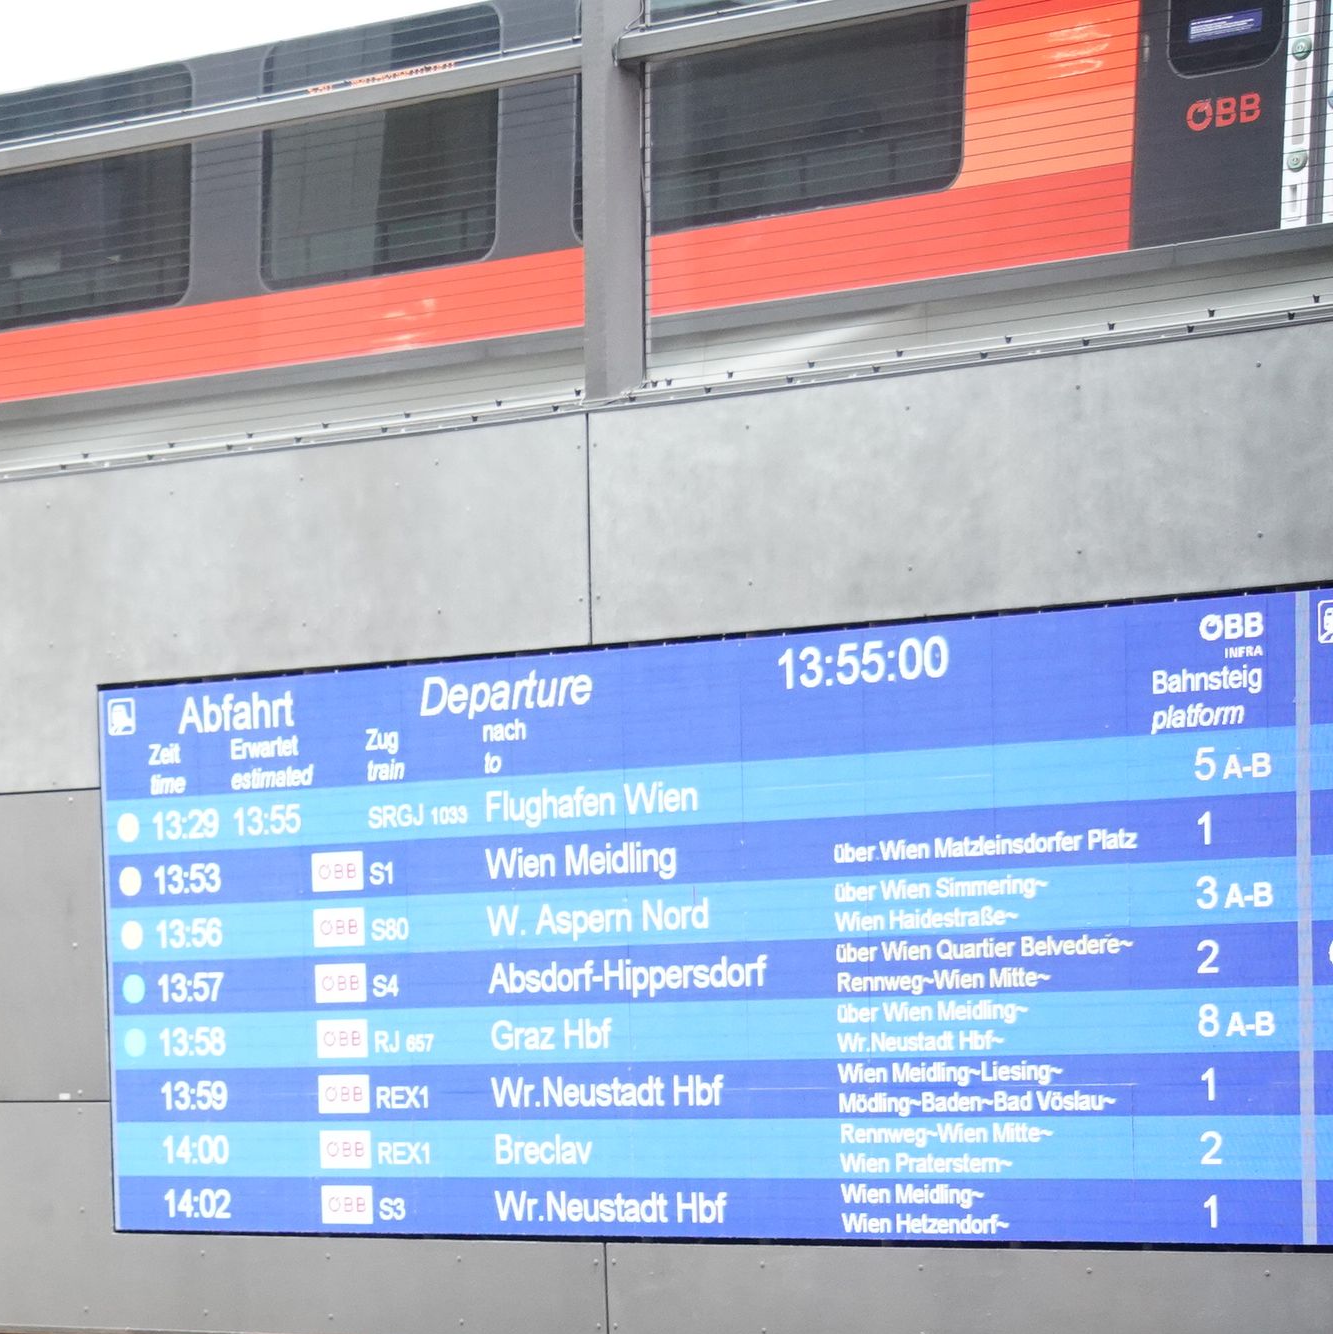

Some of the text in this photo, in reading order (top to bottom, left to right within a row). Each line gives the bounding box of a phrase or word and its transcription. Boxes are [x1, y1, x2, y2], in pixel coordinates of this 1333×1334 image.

[1186, 92, 1261, 131] ÖBB
[1199, 612, 1263, 641] ÖBB
[1225, 645, 1263, 658] INFRA
[179, 636, 948, 734] Abfahrt Departure 13:55:00
[149, 664, 1262, 765] Zeit Erwartet Zug nach Bahnsteig
[151, 703, 1244, 795] time estimated train to platform
[1195, 747, 1271, 781] 5 A-B
[153, 808, 219, 840] 13:29
[234, 804, 301, 836] 13:55
[431, 806, 468, 824] 1033
[486, 786, 615, 828] Flughafen
[624, 781, 698, 814] Wien
[1198, 811, 1211, 844] 1
[834, 829, 1137, 863] über Wien Matzleinsdorfer Platz
[155, 863, 221, 894] 13:53
[370, 862, 393, 885] S1
[485, 848, 555, 879] Wien
[565, 842, 676, 879] Meidling
[835, 882, 876, 902] über
[880, 880, 931, 900] Wien
[1196, 876, 1273, 909] 3 A-B
[156, 917, 222, 948] 13:56
[372, 918, 409, 941] S80
[487, 905, 525, 936] W.
[536, 904, 632, 941] Aspern
[642, 897, 709, 931] Nord
[835, 911, 885, 932] Wien
[836, 943, 877, 963] über
[881, 941, 932, 961] Wien
[937, 938, 1016, 960] Quartier
[1197, 940, 1219, 973] 2
[158, 972, 224, 1002] 13:57
[373, 975, 399, 997] S4
[489, 955, 767, 998] Absdorf-Hippersdorf
[837, 1003, 879, 1023] über
[883, 1002, 933, 1022] Wien
[1198, 1004, 1275, 1037] 8 A-B
[160, 1026, 226, 1056] 13:58
[375, 1031, 400, 1053] RJ
[406, 1034, 434, 1052] 657
[491, 1020, 555, 1050] Graz
[564, 1018, 612, 1049] Hbf
[837, 1031, 954, 1052] Wr.Neustadt
[838, 1063, 888, 1083] Wien
[1201, 1068, 1215, 1100] 1
[161, 1081, 228, 1110] 13:59
[376, 1086, 428, 1108] REX1
[491, 1076, 664, 1107] Wr.Neustadt
[674, 1074, 723, 1106] Hbf
[163, 1135, 229, 1164] 14:00
[378, 1142, 430, 1165] REX1
[495, 1134, 592, 1164] Breclav
[840, 1153, 890, 1173] Wien
[1201, 1131, 1222, 1164] 2
[165, 1189, 231, 1218] 14:02
[380, 1197, 405, 1220] S3
[495, 1191, 668, 1222] Wr.Neustadt
[677, 1192, 727, 1223] Hbf
[841, 1184, 891, 1203] Wien
[842, 1213, 891, 1233] Wien
[1204, 1195, 1217, 1228] 1
